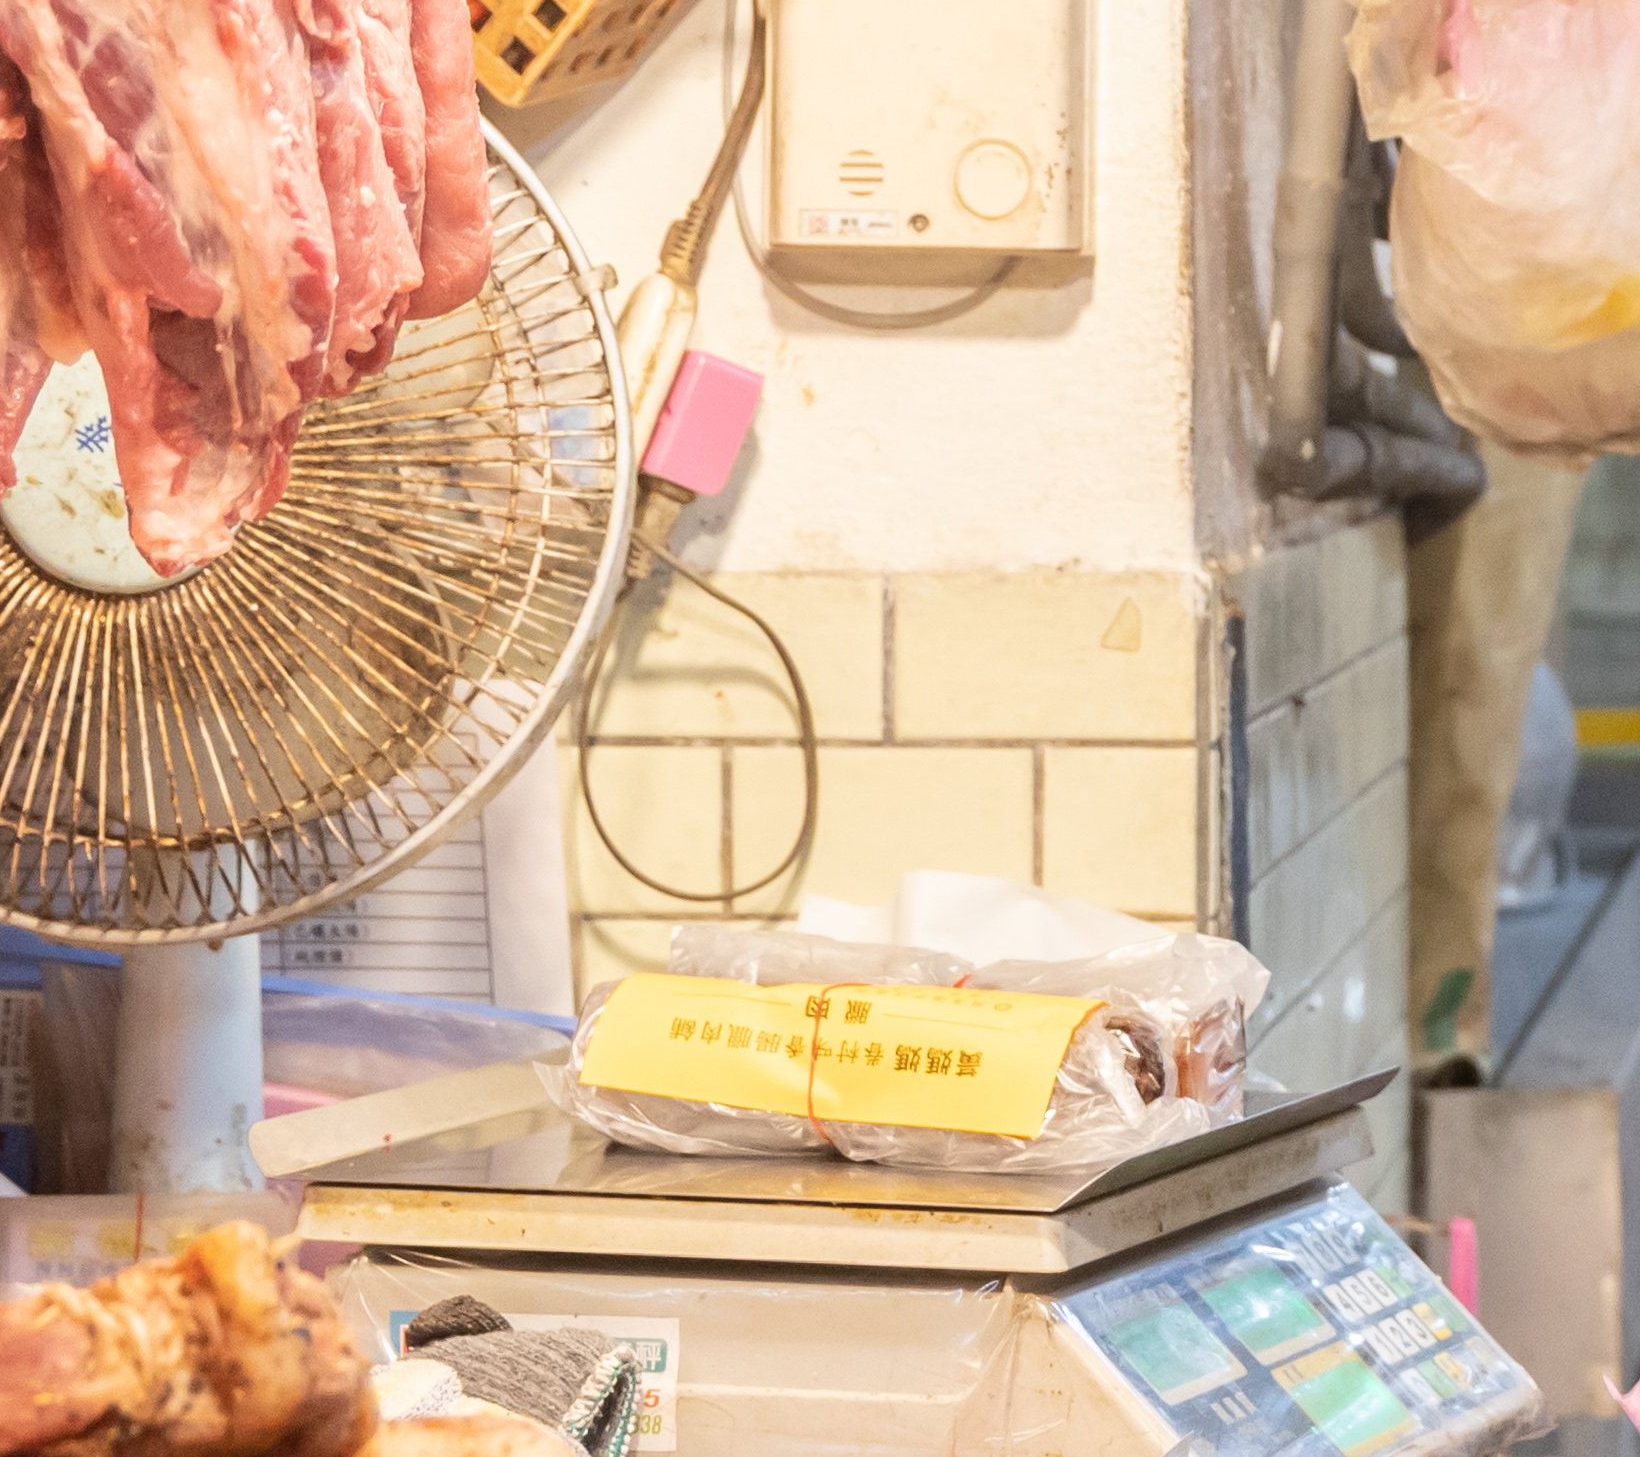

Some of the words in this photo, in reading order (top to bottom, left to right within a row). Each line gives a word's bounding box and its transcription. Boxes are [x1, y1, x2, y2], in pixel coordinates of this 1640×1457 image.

[893, 1044, 984, 1078] 黃媽媽
[1338, 1291, 1354, 1314] 4
[1352, 1284, 1370, 1305] 5
[1368, 1275, 1389, 1298] 6
[1376, 1336, 1394, 1356] 1
[1391, 1327, 1409, 1348] 2
[1406, 1317, 1429, 1340] 3
